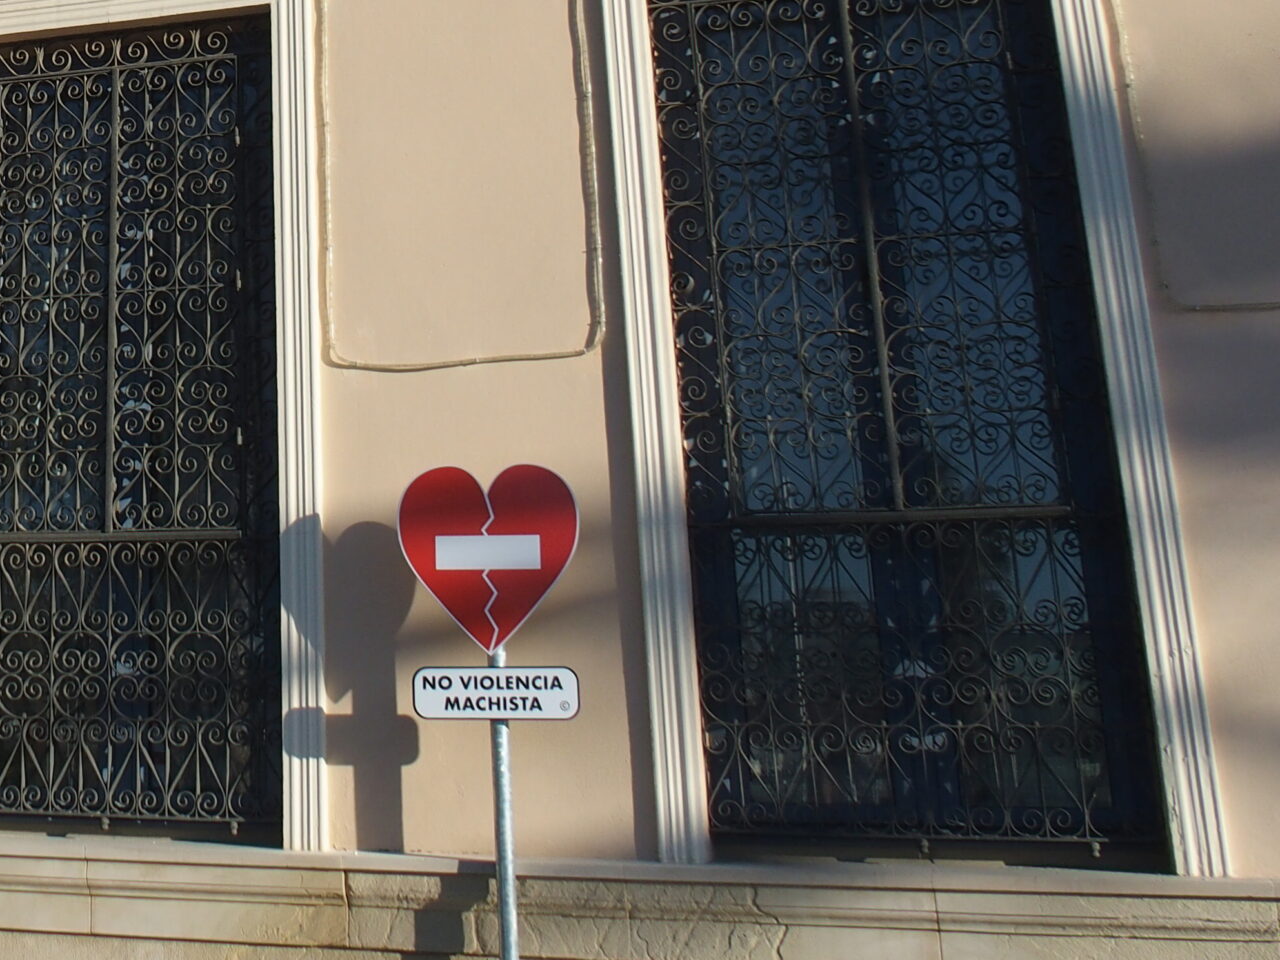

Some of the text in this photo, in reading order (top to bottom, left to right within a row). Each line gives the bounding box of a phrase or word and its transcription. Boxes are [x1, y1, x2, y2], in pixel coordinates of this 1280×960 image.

[422, 675, 564, 690] NO VIOLENCIA
[444, 696, 543, 711] MACHISTA
